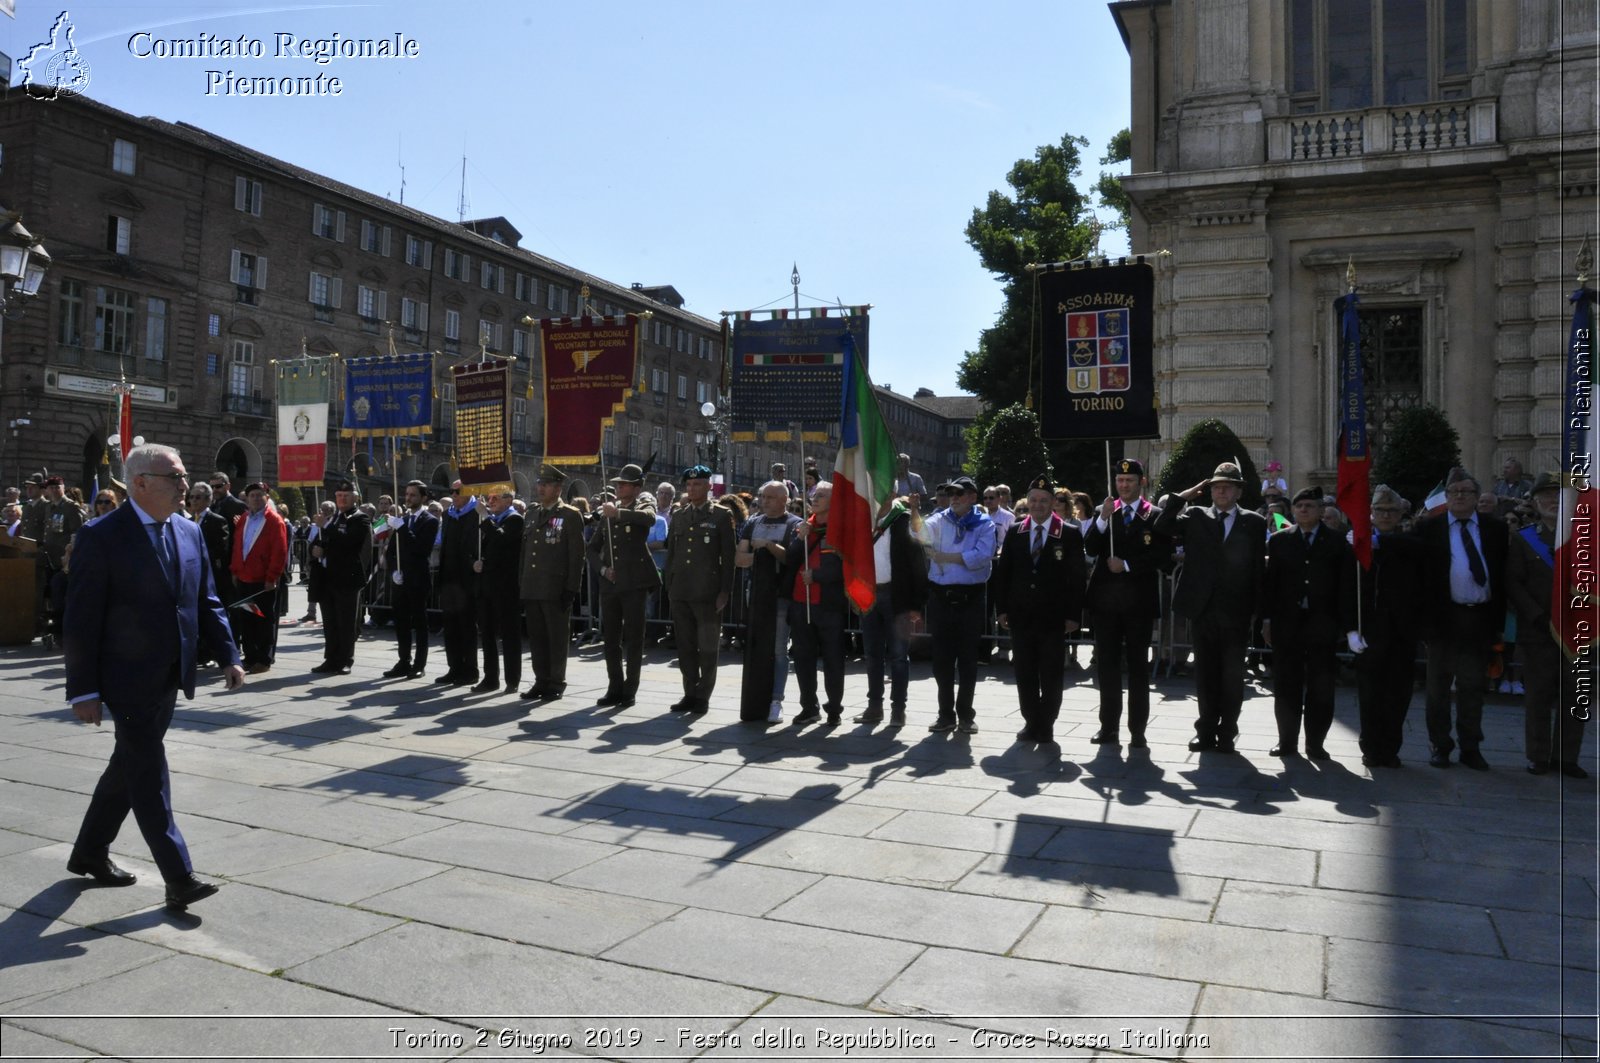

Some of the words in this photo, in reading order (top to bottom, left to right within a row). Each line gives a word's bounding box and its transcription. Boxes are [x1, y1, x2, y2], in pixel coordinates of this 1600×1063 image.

[1058, 292, 1136, 314] ASSOARMA
[549, 331, 592, 341] ASSOCIAZIONE
[593, 329, 631, 338] NAZIONALE
[779, 336, 820, 346] PIEMONTE
[554, 341, 588, 351] VOLONTARI
[598, 339, 627, 348] GUERRA
[1348, 342, 1358, 382] TORINO
[1071, 396, 1125, 412] TORINO
